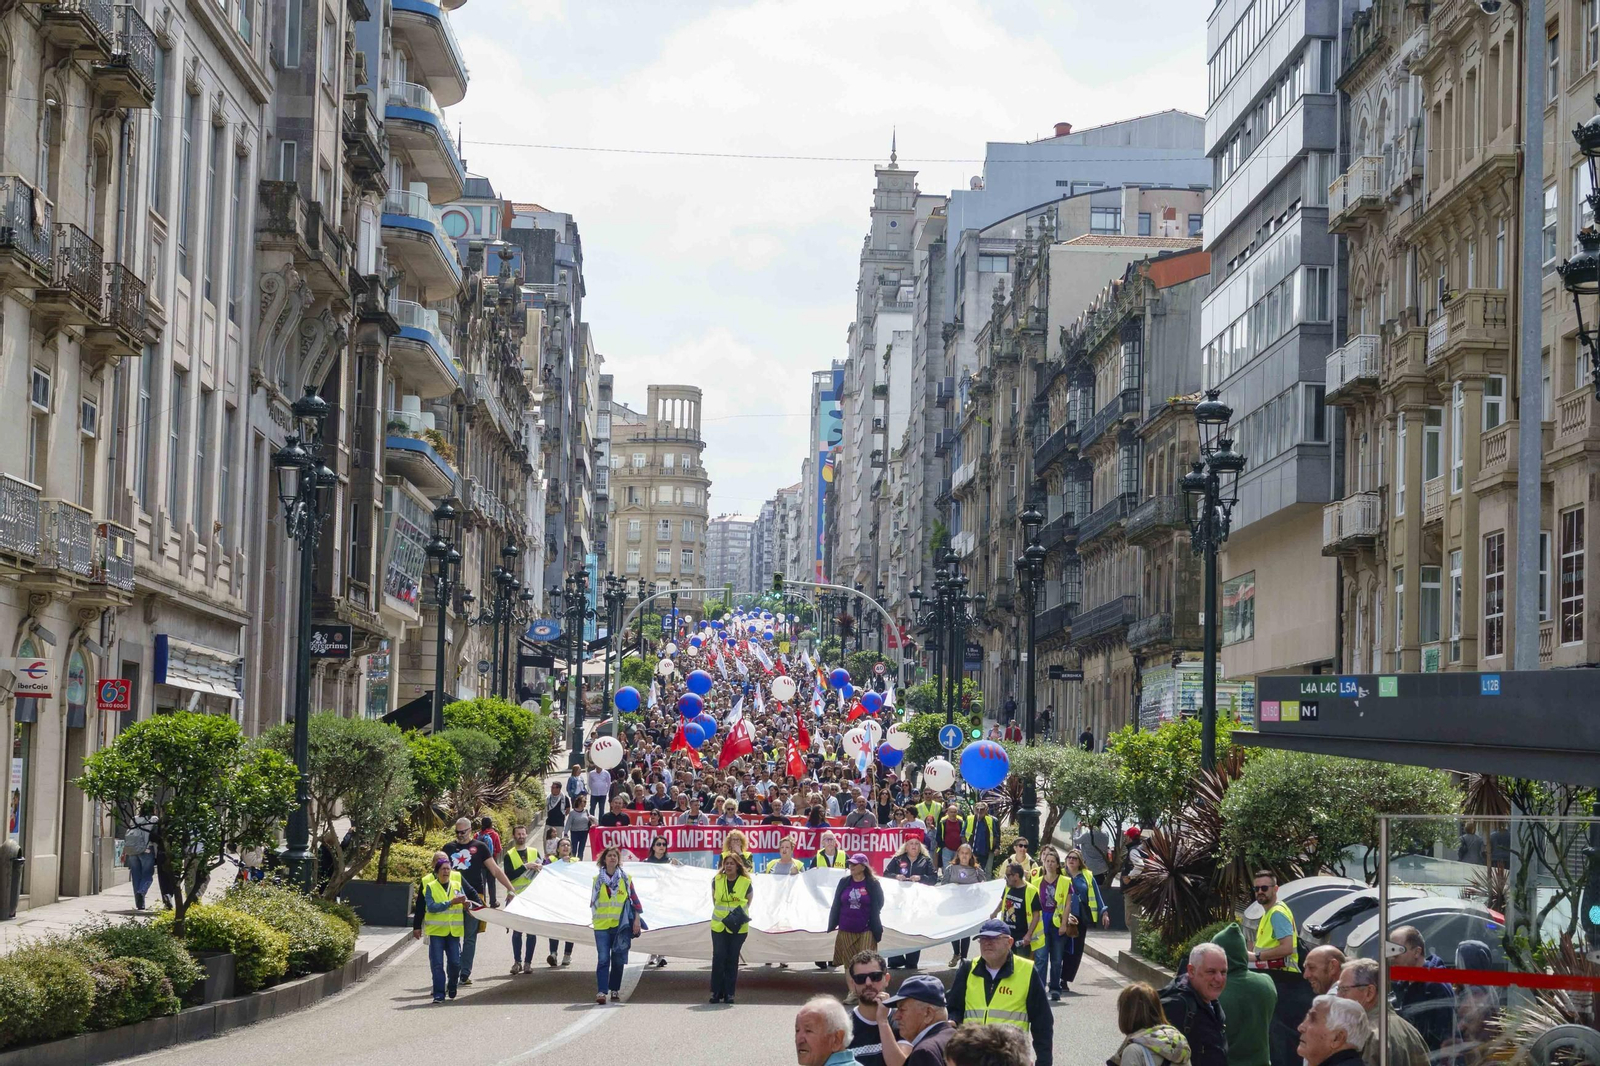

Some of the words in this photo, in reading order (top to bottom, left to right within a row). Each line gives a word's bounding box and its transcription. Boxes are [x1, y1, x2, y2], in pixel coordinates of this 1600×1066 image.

[665, 617, 672, 626] P
[17, 683, 48, 691] iberCaja
[1300, 682, 1318, 694] L4A
[1320, 682, 1337, 693] L4C
[1340, 682, 1357, 693] L5A
[1381, 682, 1394, 692] L7
[1482, 680, 1499, 691] L12B
[1262, 706, 1279, 717] L15C
[1281, 706, 1299, 717] L17
[1302, 705, 1317, 717] N1
[602, 830, 657, 848] CONTRA
[663, 829, 673, 849] O
[677, 829, 781, 850] IMPERIISMO
[998, 986, 1013, 995] CIG
